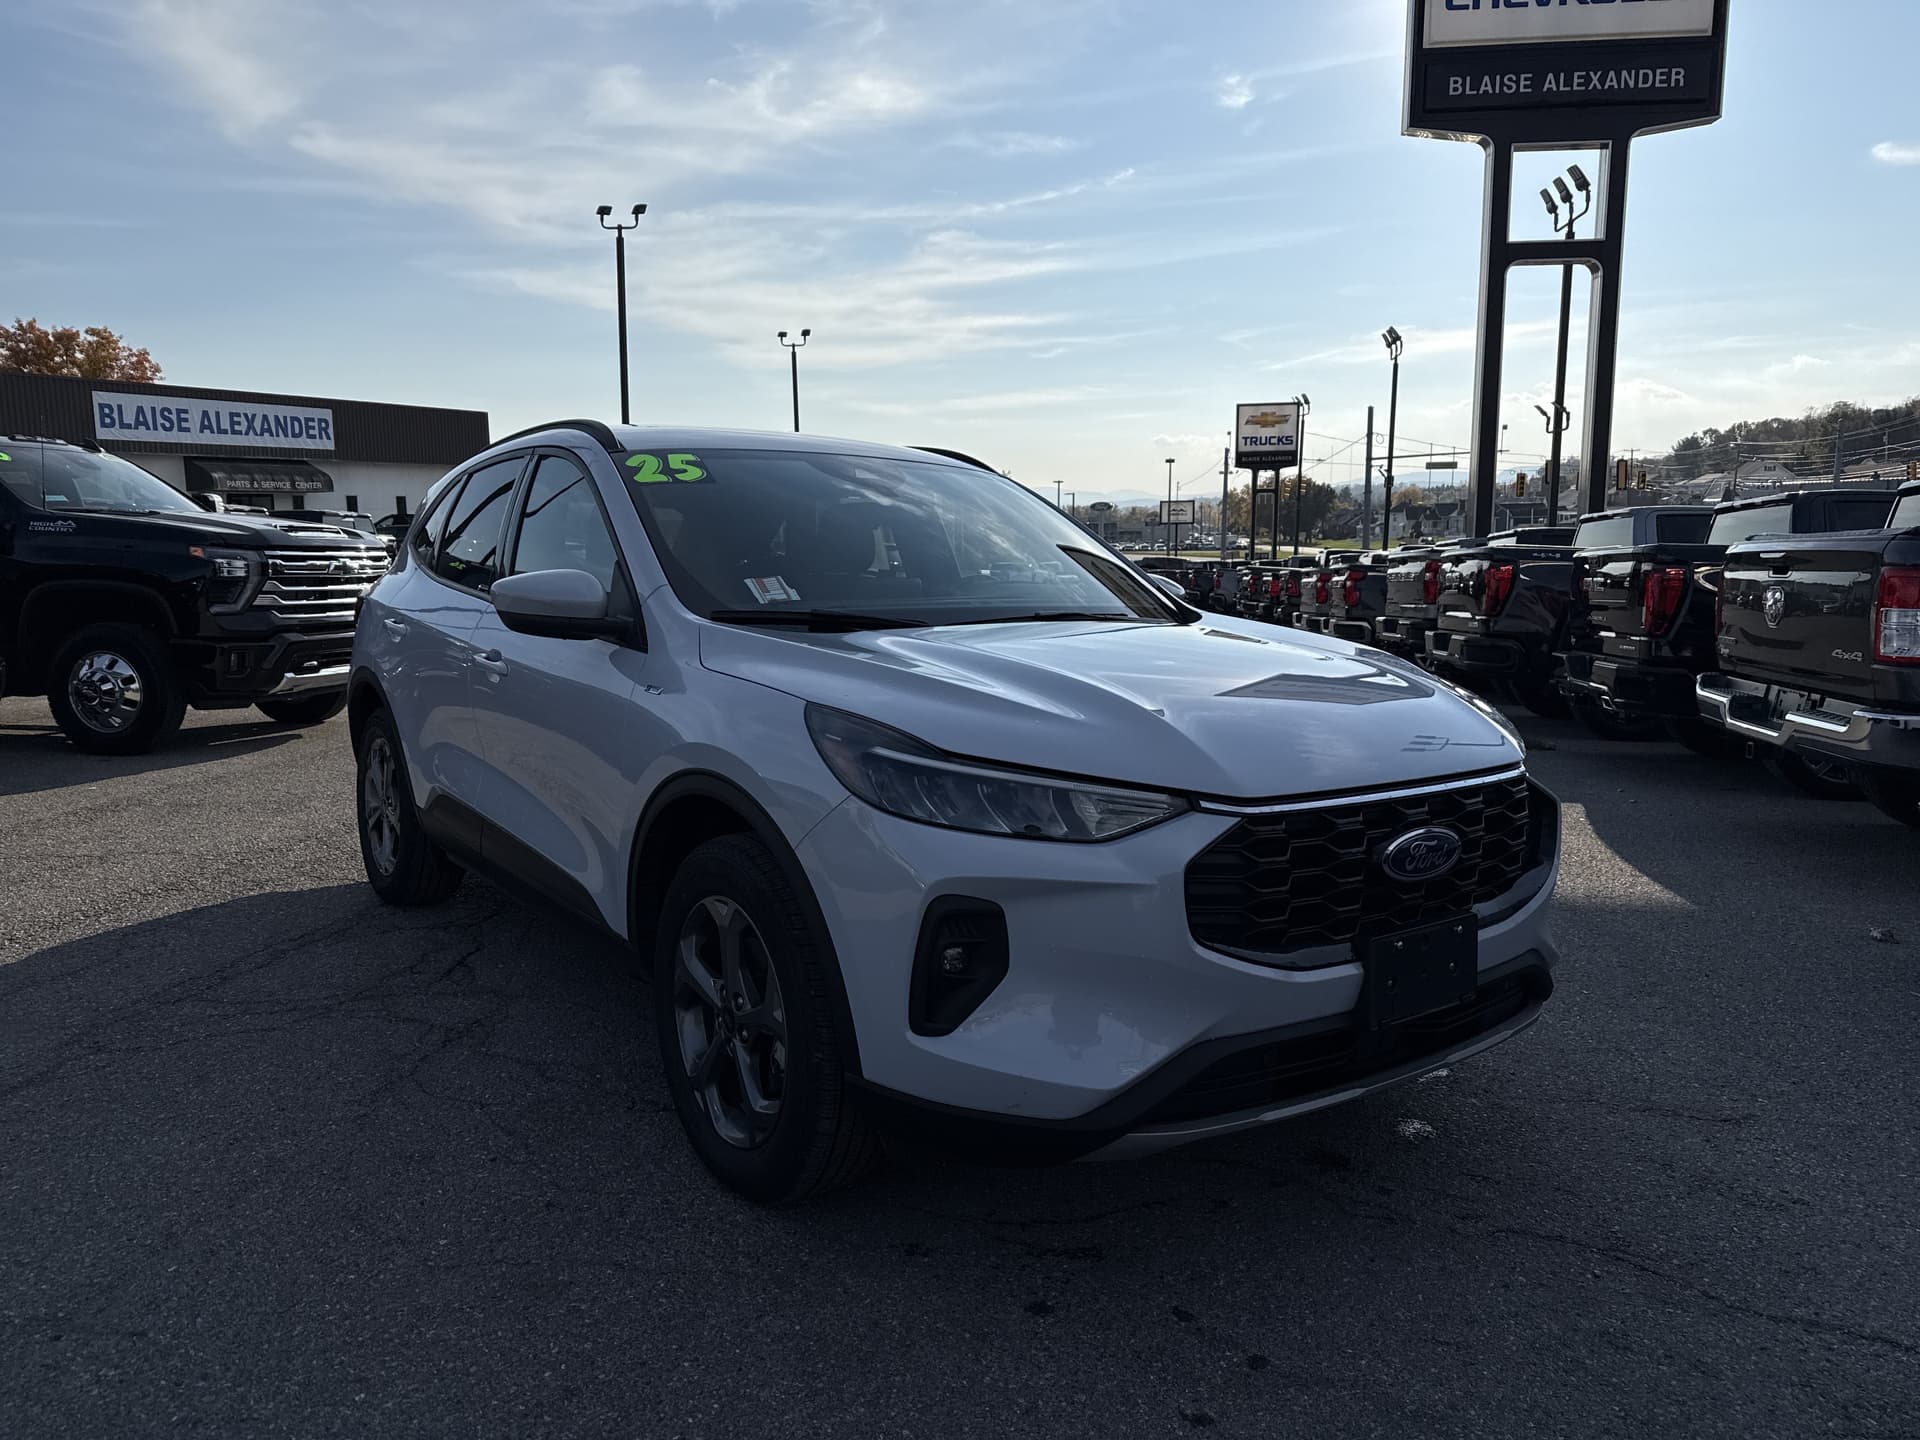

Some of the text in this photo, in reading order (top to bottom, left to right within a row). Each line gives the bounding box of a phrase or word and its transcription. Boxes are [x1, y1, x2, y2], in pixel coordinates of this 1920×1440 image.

[1448, 67, 1686, 96] BLAISE ALEXANDER
[97, 402, 332, 441] BLAISE ALEXANDER
[1241, 435, 1294, 447] TRUCKS
[625, 453, 707, 483] 25
[226, 480, 323, 489] PARTS & SERVICE CENTER
[1405, 839, 1448, 871] Ford
